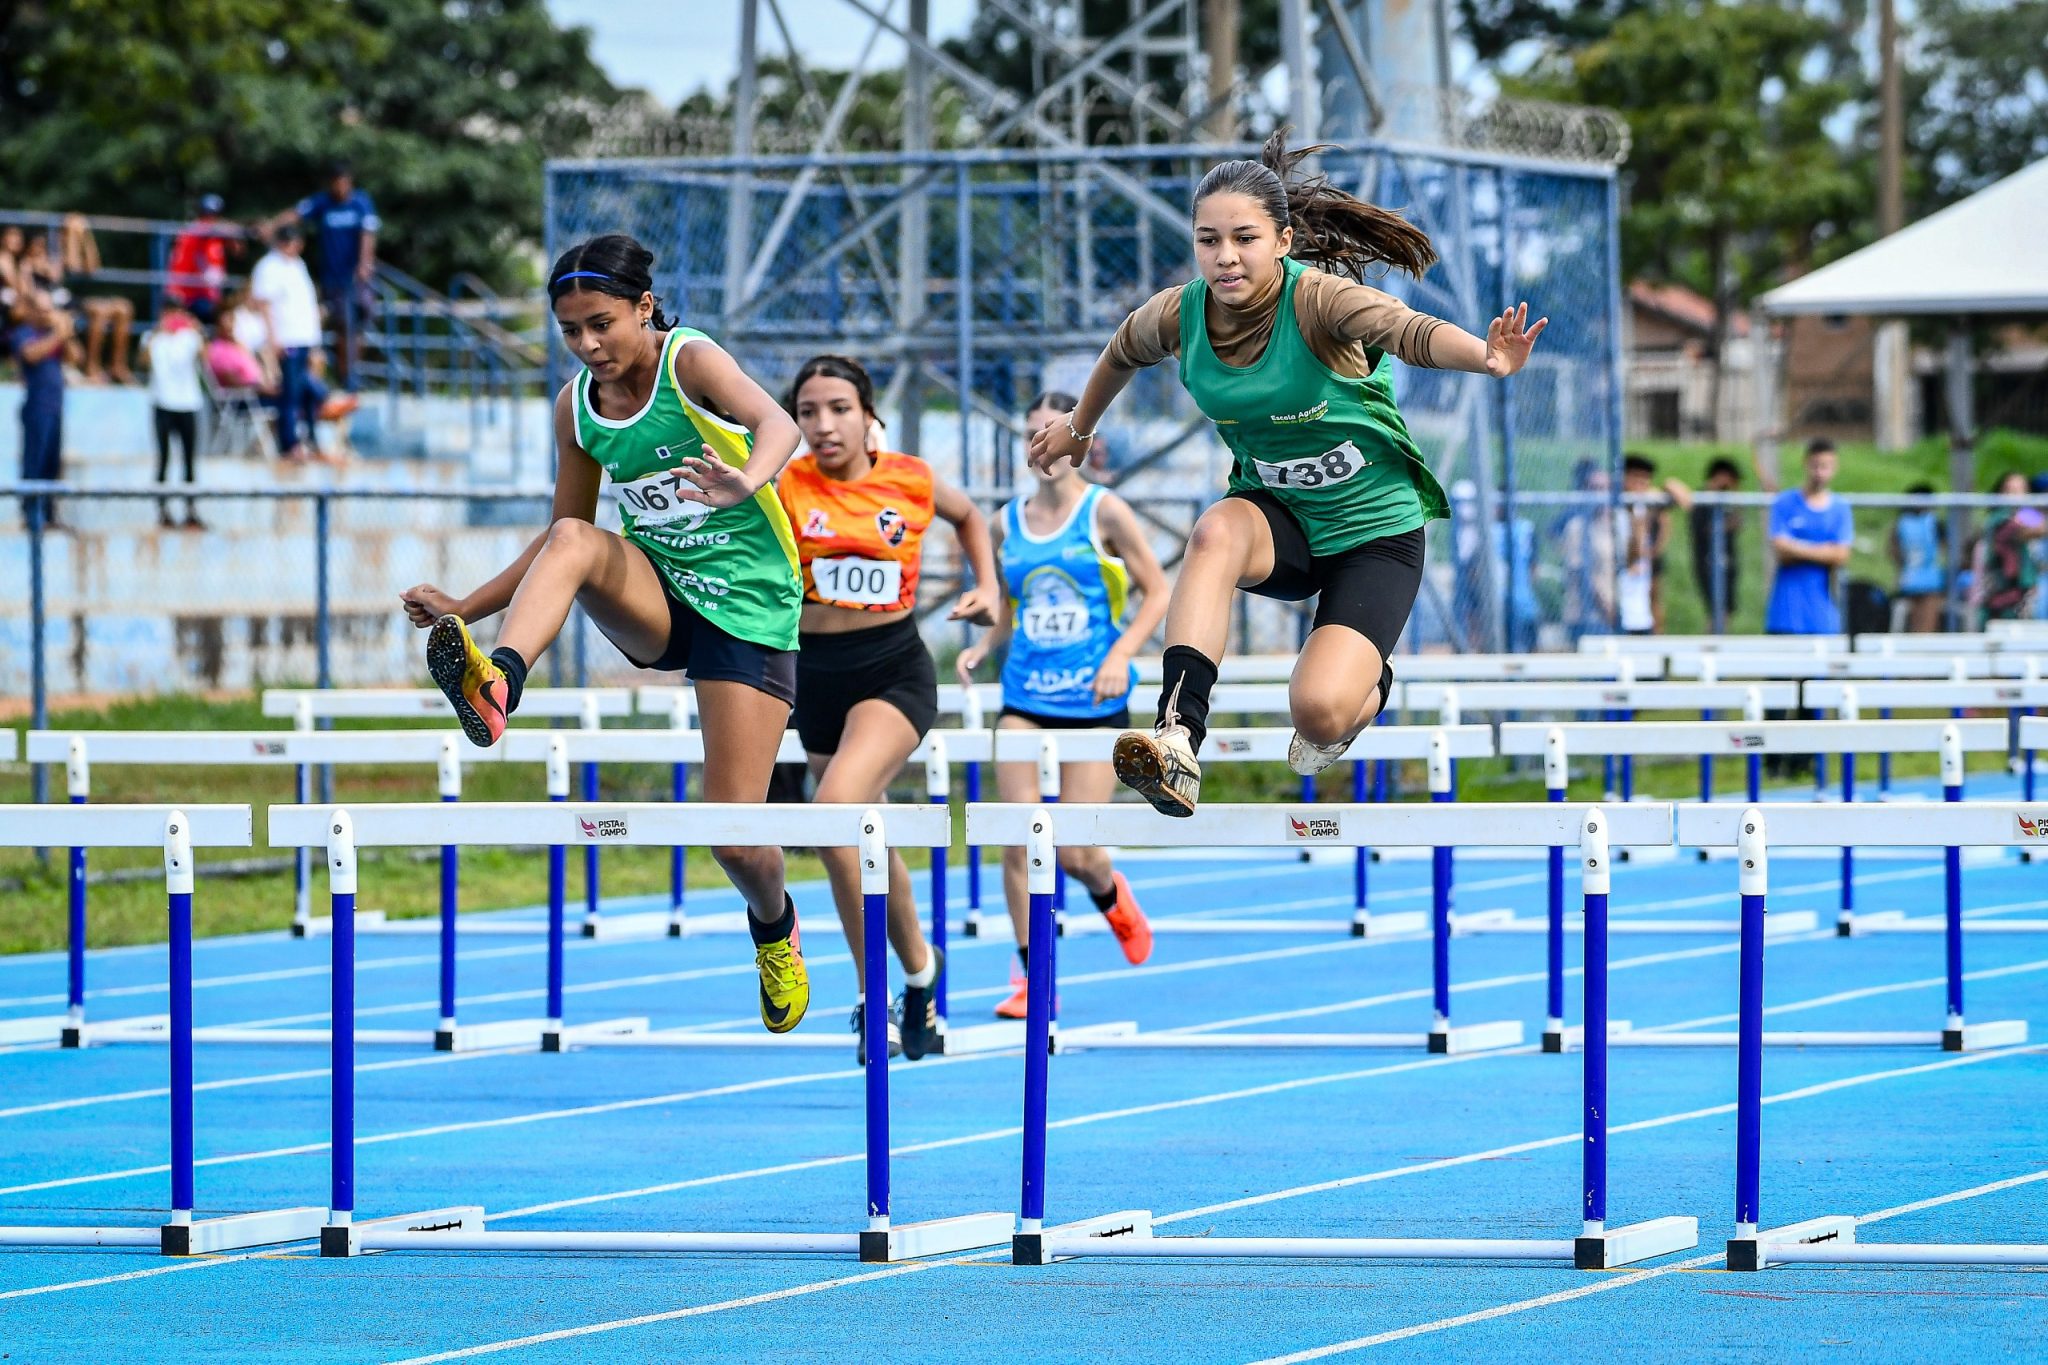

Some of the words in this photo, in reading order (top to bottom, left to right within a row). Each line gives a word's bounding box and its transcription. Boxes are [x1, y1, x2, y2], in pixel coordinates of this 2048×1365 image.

[623, 477, 685, 511] 067
[827, 565, 885, 594] 100
[1030, 611, 1076, 633] 747
[598, 820, 619, 829] PISTA
[1310, 820, 1332, 828] PISTA
[600, 828, 627, 837] CAMPO
[1311, 828, 1339, 837] CAMPO
